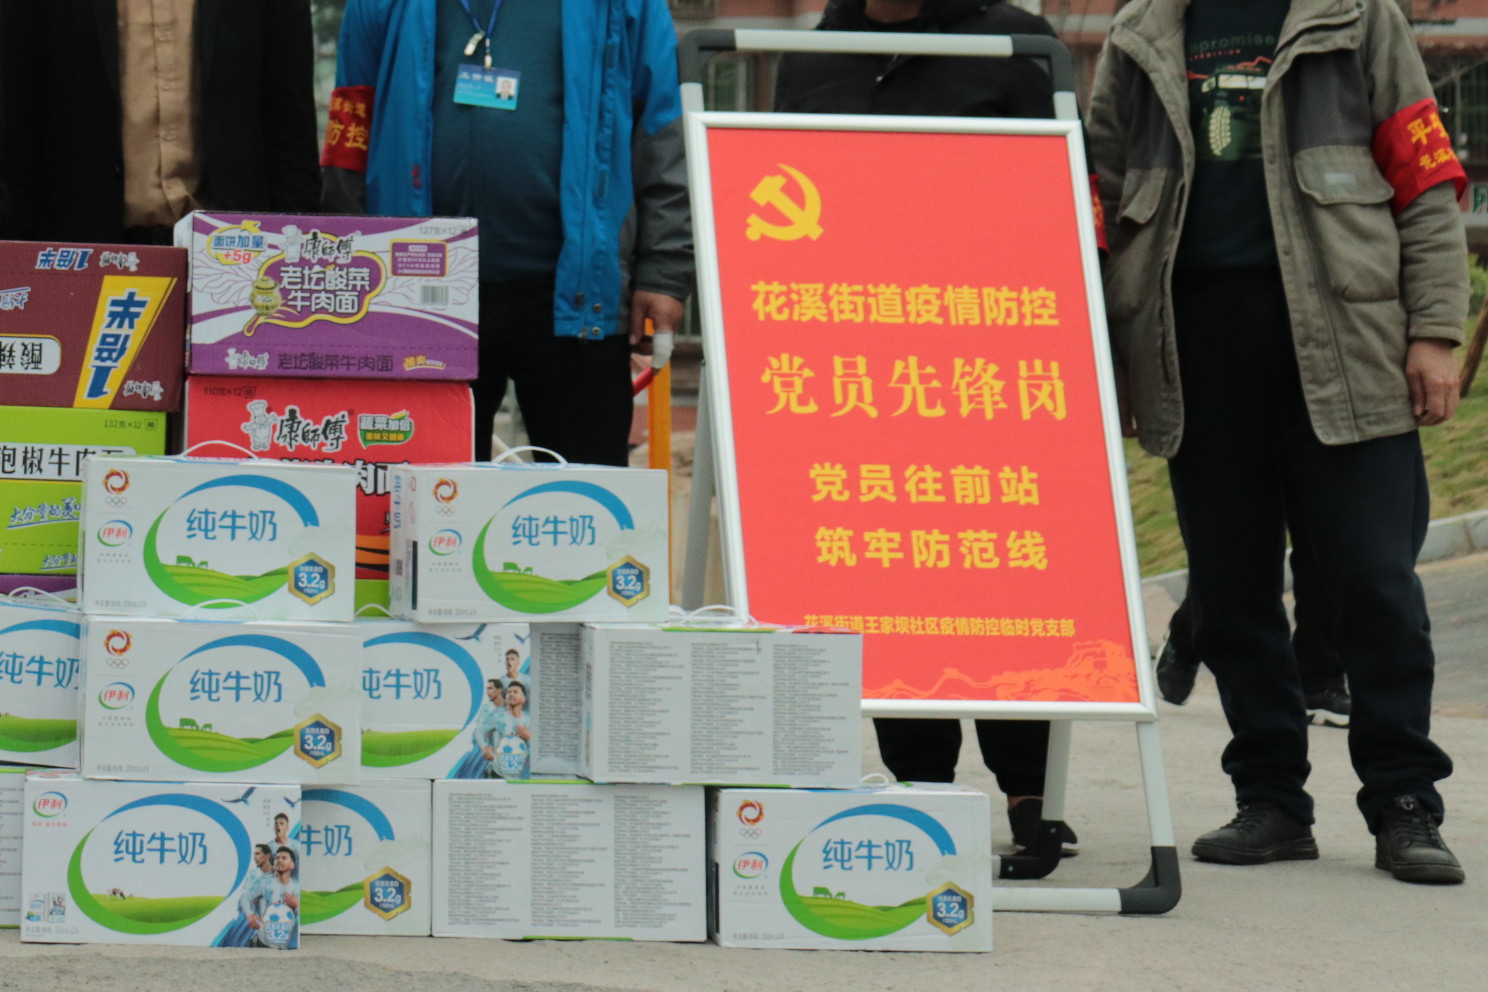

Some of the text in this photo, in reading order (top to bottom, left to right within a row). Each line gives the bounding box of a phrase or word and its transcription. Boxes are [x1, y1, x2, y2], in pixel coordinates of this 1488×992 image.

[213, 235, 265, 250] 面饼加量
[36, 248, 93, 270] 1倍半
[223, 250, 252, 264] +5g
[280, 266, 370, 291] 老坛酸菜
[287, 291, 359, 314] 牛肉面
[750, 281, 1059, 326] 花溪街道疫情防控
[84, 289, 150, 400] 1倍半
[277, 352, 394, 371] 老坛酸菜牛肉面
[760, 352, 1068, 420] 党员先锋岗
[360, 415, 411, 431] 蔬菜加倍
[809, 462, 1040, 506] 党员往前站
[102, 525, 127, 539] 伊利
[185, 508, 278, 541] 纯牛奶
[511, 515, 596, 546] 纯牛奶
[433, 536, 457, 547] 伊利
[814, 526, 1048, 570] 筑牢防范线
[297, 573, 326, 590] 3.2g
[616, 574, 641, 592] 3.2g
[104, 689, 130, 702] 伊利
[189, 669, 283, 703] 纯牛奶
[304, 735, 332, 752] 3.2g
[38, 798, 62, 810] 伊利
[113, 830, 208, 865] 纯牛奶
[300, 824, 353, 856] 牛奶
[822, 838, 914, 871] 纯牛奶
[738, 859, 763, 871] 伊利
[374, 887, 402, 903] 3.2g
[936, 902, 965, 919] 3.2g
